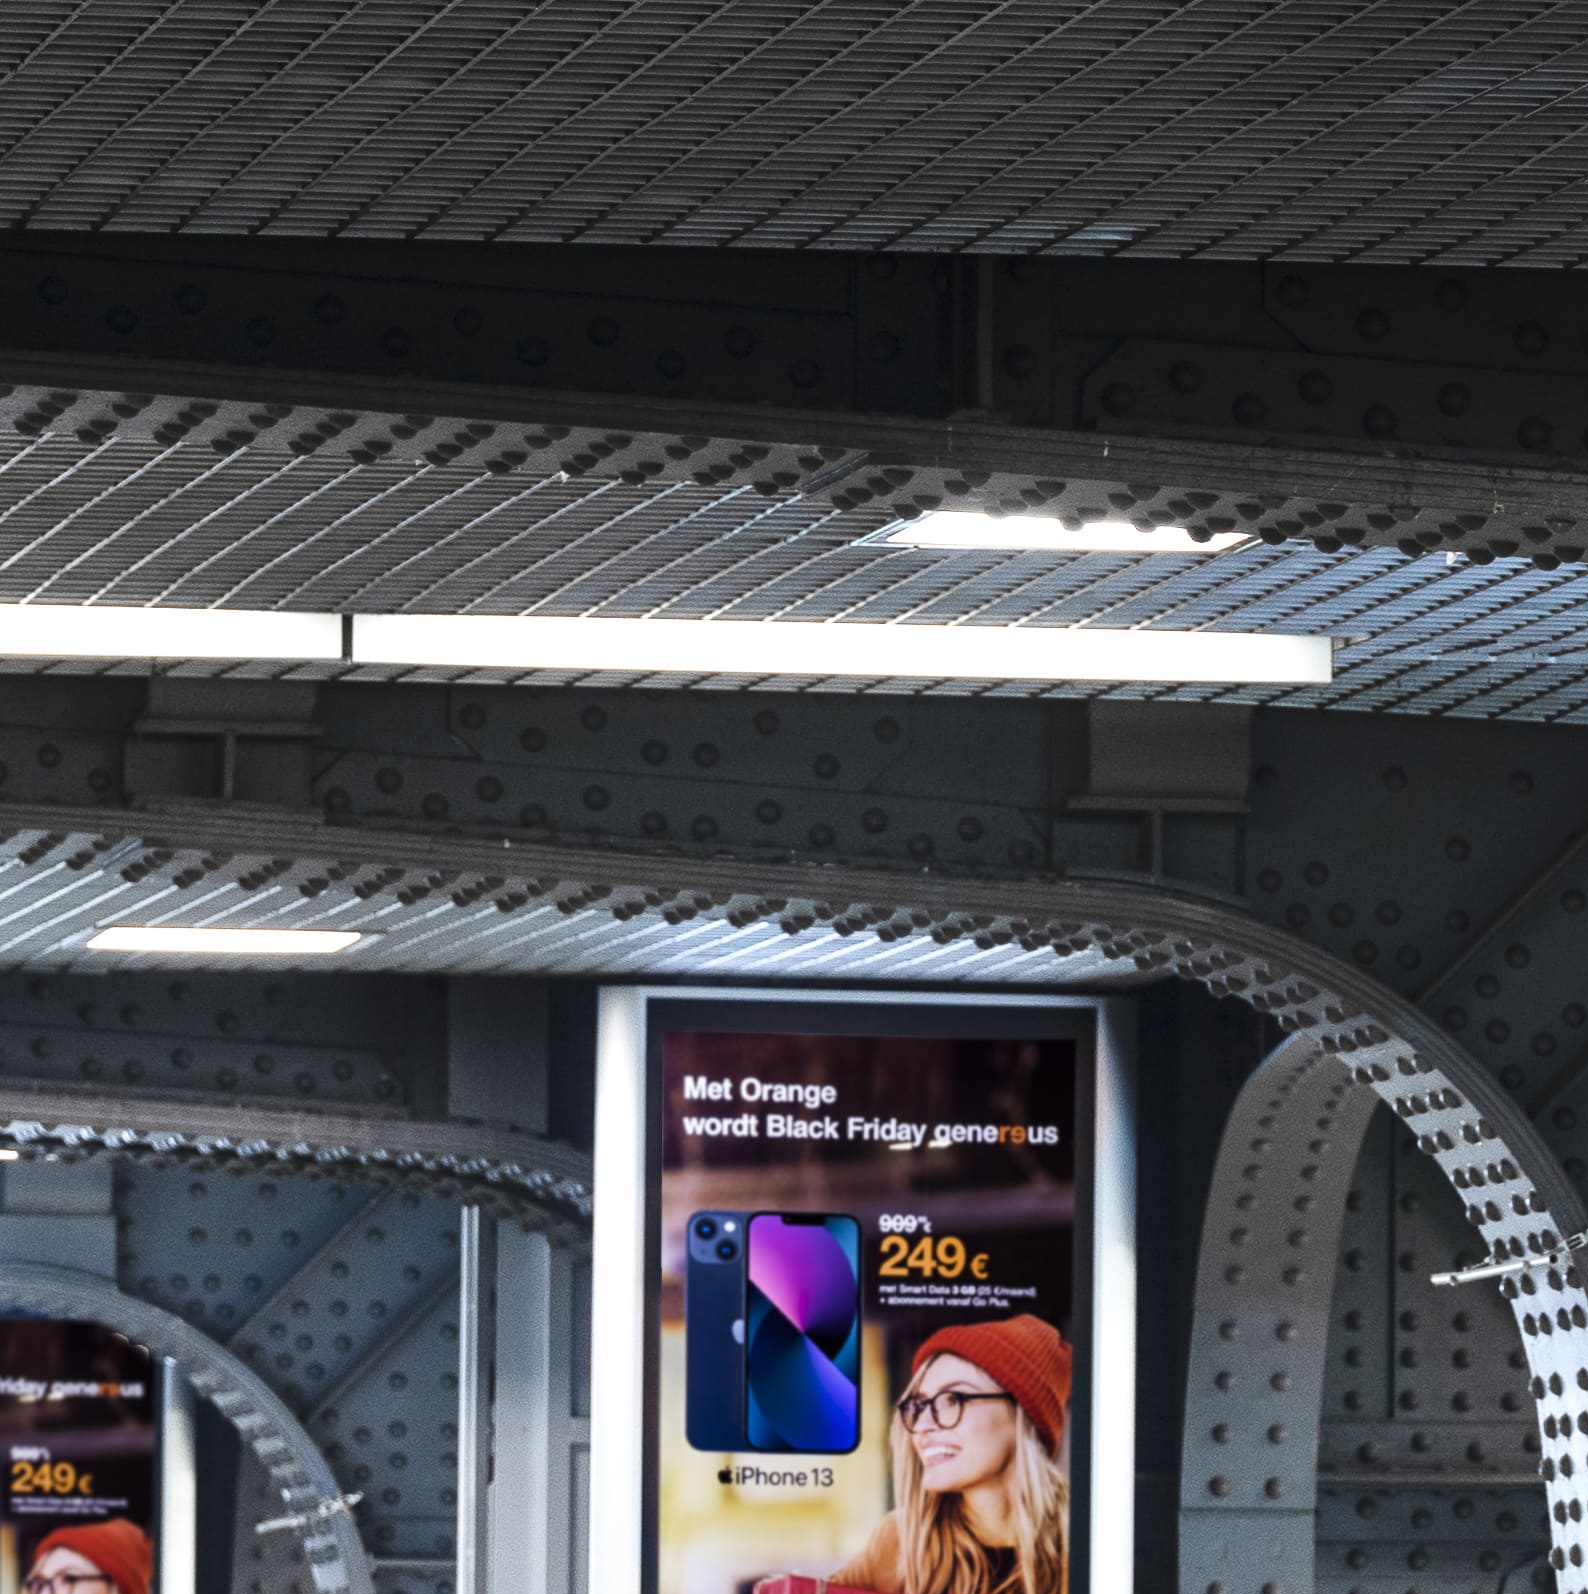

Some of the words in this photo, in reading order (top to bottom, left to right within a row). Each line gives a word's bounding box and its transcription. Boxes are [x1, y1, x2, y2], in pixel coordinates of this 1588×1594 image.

[683, 1076, 732, 1101] Met
[740, 1078, 837, 1108] Orange
[683, 1114, 758, 1137] wordt
[766, 1115, 839, 1139] Black
[847, 1117, 926, 1146] Friday
[934, 1125, 1059, 1145] genereus
[879, 1235, 966, 1278] 249
[970, 1253, 990, 1280] €
[11, 1462, 76, 1493] 249
[735, 1466, 808, 1486] iPhone
[811, 1468, 834, 1487] 13
